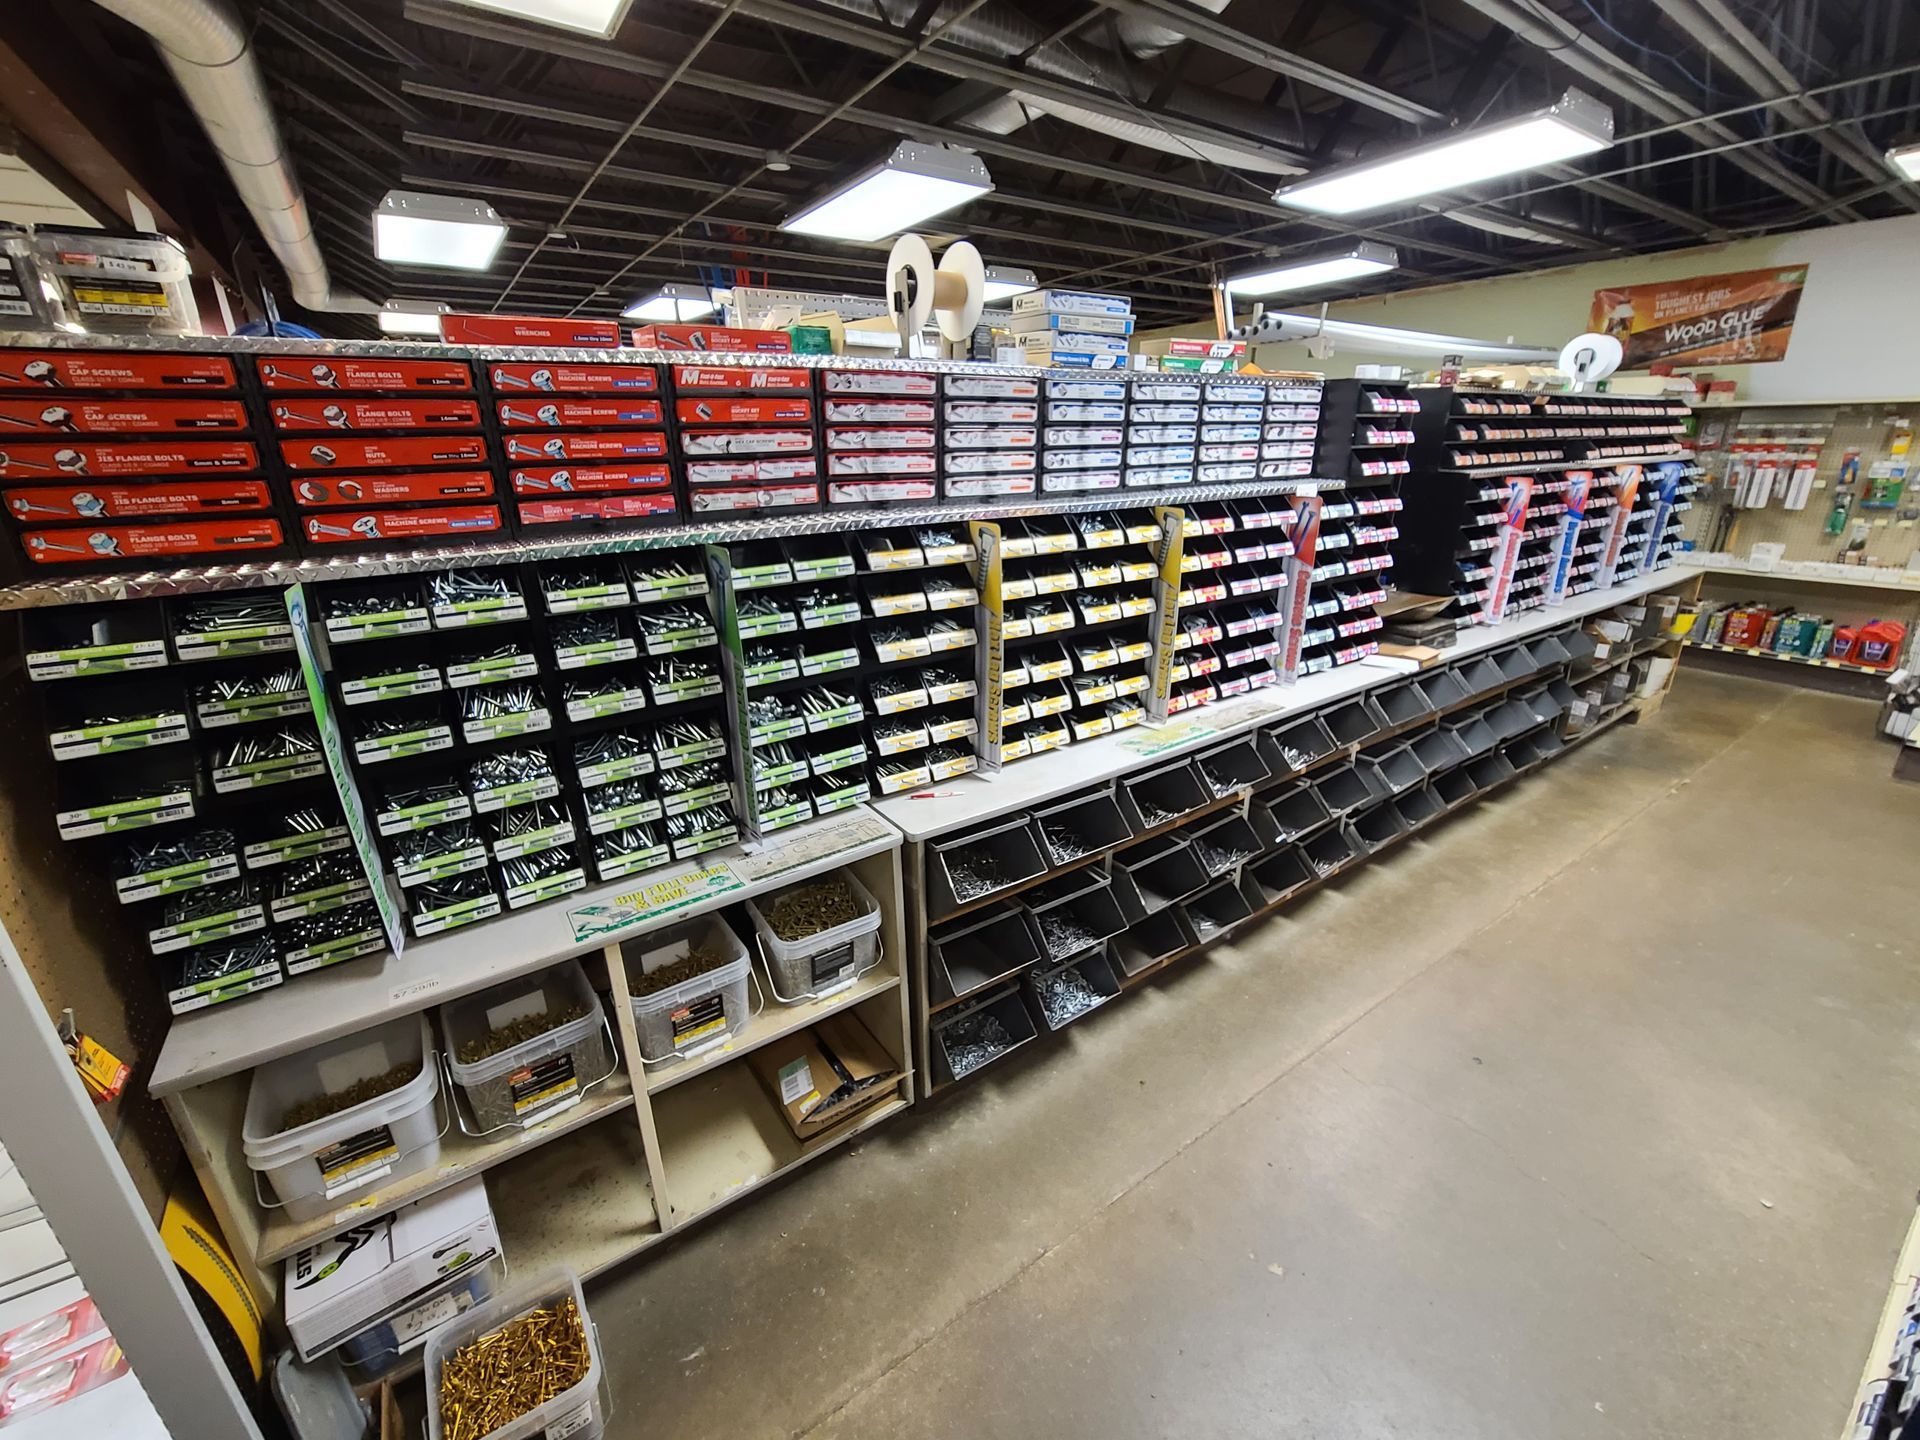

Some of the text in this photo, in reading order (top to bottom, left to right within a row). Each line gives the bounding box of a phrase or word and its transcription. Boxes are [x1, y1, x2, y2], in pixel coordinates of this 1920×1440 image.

[1654, 310, 1664, 320] ON
[1665, 306, 1692, 318] PLANET
[1655, 288, 1732, 310] TOUGHEST JOBS
[1664, 306, 1764, 344] WOOD GLUE
[1156, 588, 1178, 699] Hex Lag Screws
[1284, 570, 1310, 672] Concrete Screws
[988, 616, 1002, 746] Hex Lag Screws
[732, 662, 758, 824] Carriage Screws
[326, 732, 396, 932] Carriage Screws
[634, 900, 651, 912] &
